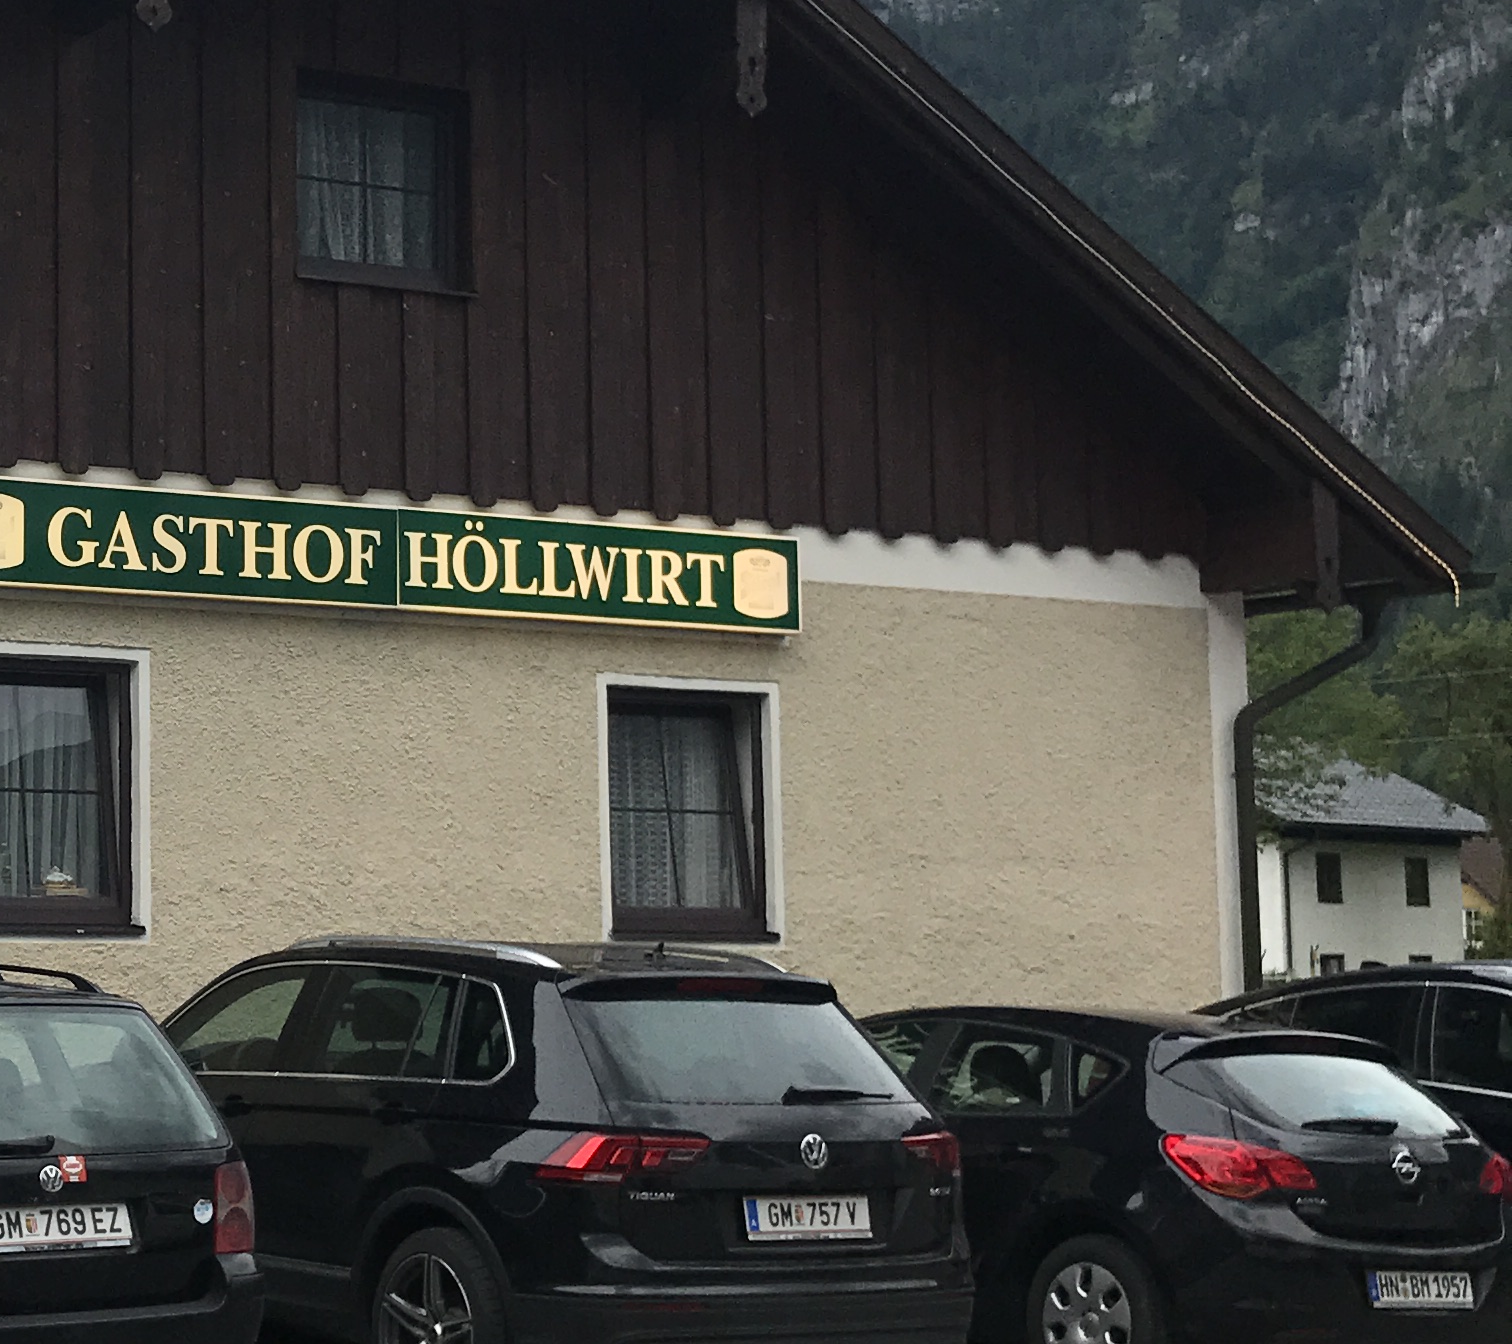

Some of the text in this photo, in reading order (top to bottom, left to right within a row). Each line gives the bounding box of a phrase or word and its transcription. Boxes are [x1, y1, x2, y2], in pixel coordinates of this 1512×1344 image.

[47, 506, 726, 608] GASTHOF HÖLLWIRT
[39, 1207, 87, 1237] 769
[90, 1206, 123, 1234] EZ
[768, 1201, 857, 1227] GM 757 V
[1379, 1274, 1400, 1298] HN
[1432, 1274, 1469, 1299] 1957
